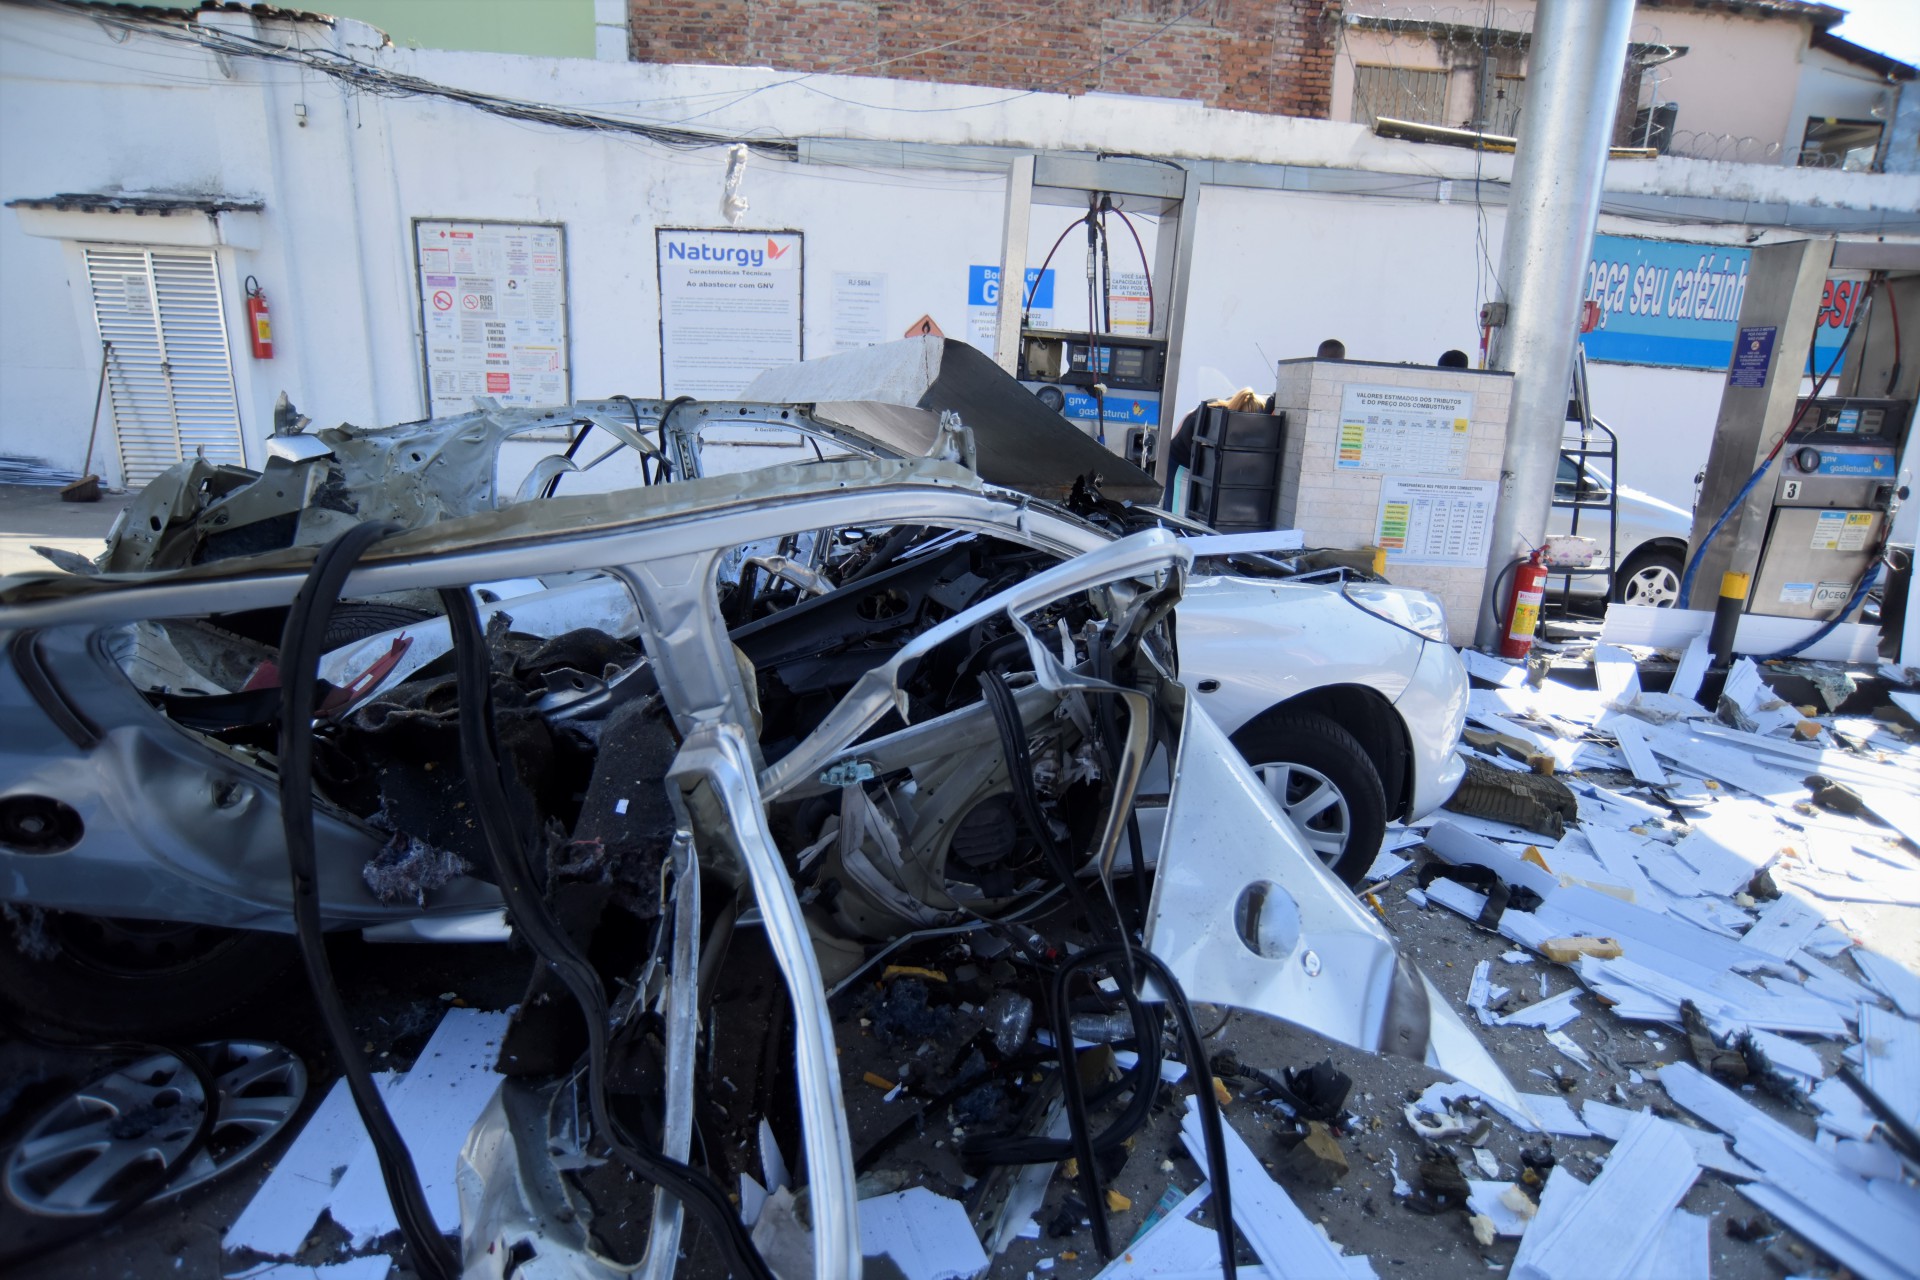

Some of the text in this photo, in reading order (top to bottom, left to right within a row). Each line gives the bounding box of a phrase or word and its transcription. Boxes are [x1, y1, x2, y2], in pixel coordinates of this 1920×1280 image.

[668, 242, 764, 267] Naturgy
[698, 281, 737, 289] abastecer
[1630, 264, 1669, 317] seu
[1667, 253, 1747, 322] cafézinh
[1073, 353, 1087, 363] GNV
[1068, 397, 1088, 406] gnv
[1384, 394, 1419, 402] ESTIMADOS
[1412, 402, 1455, 411] COMBUSTÍVEIS
[1821, 455, 1837, 464] gnv
[1829, 463, 1872, 474] gasNatural
[1787, 483, 1797, 499] 3
[1828, 591, 1847, 599] CEG
